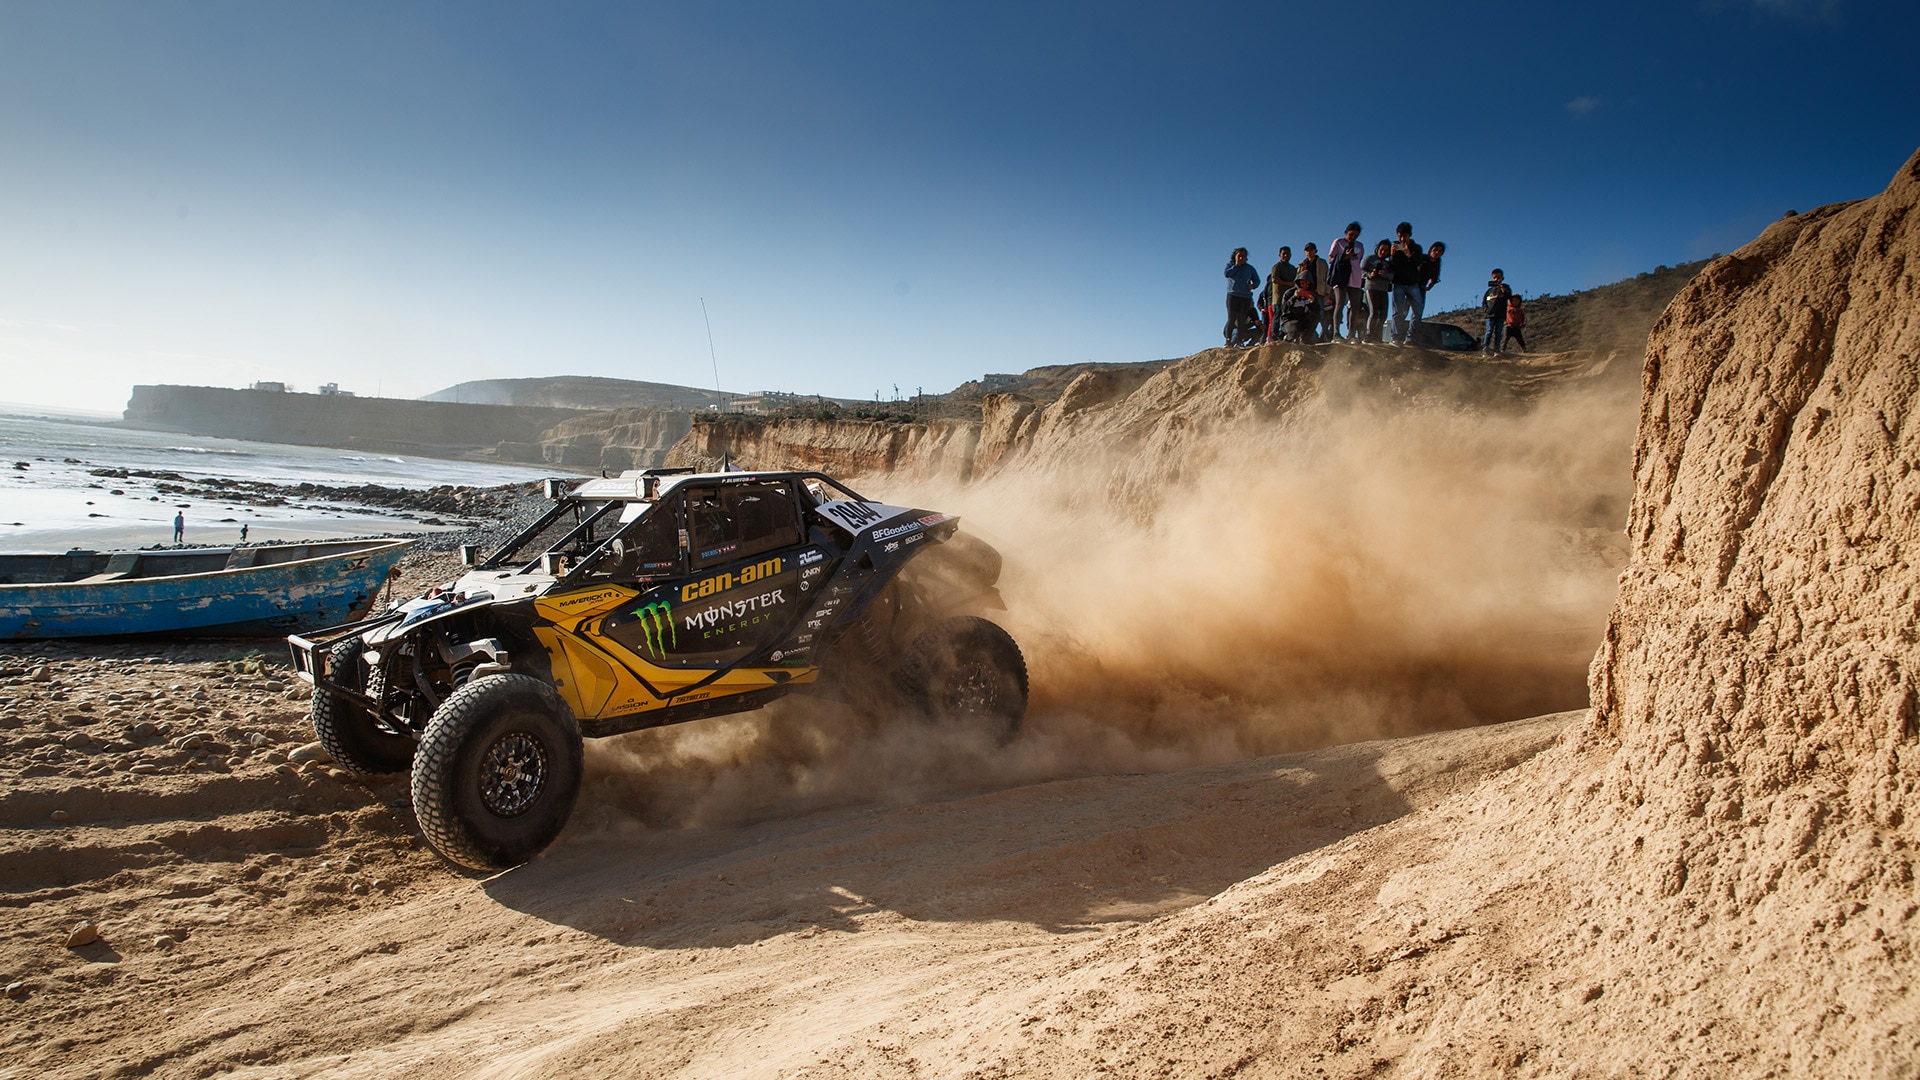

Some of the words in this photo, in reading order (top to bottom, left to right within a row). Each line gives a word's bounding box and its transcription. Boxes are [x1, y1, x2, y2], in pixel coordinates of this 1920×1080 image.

[828, 501, 883, 530] 2944
[872, 521, 921, 540] BFGoodrich
[681, 557, 782, 603] can-am
[559, 593, 603, 607] MAVERICK
[703, 612, 772, 639] ENERGY
[611, 700, 649, 710] VISION
